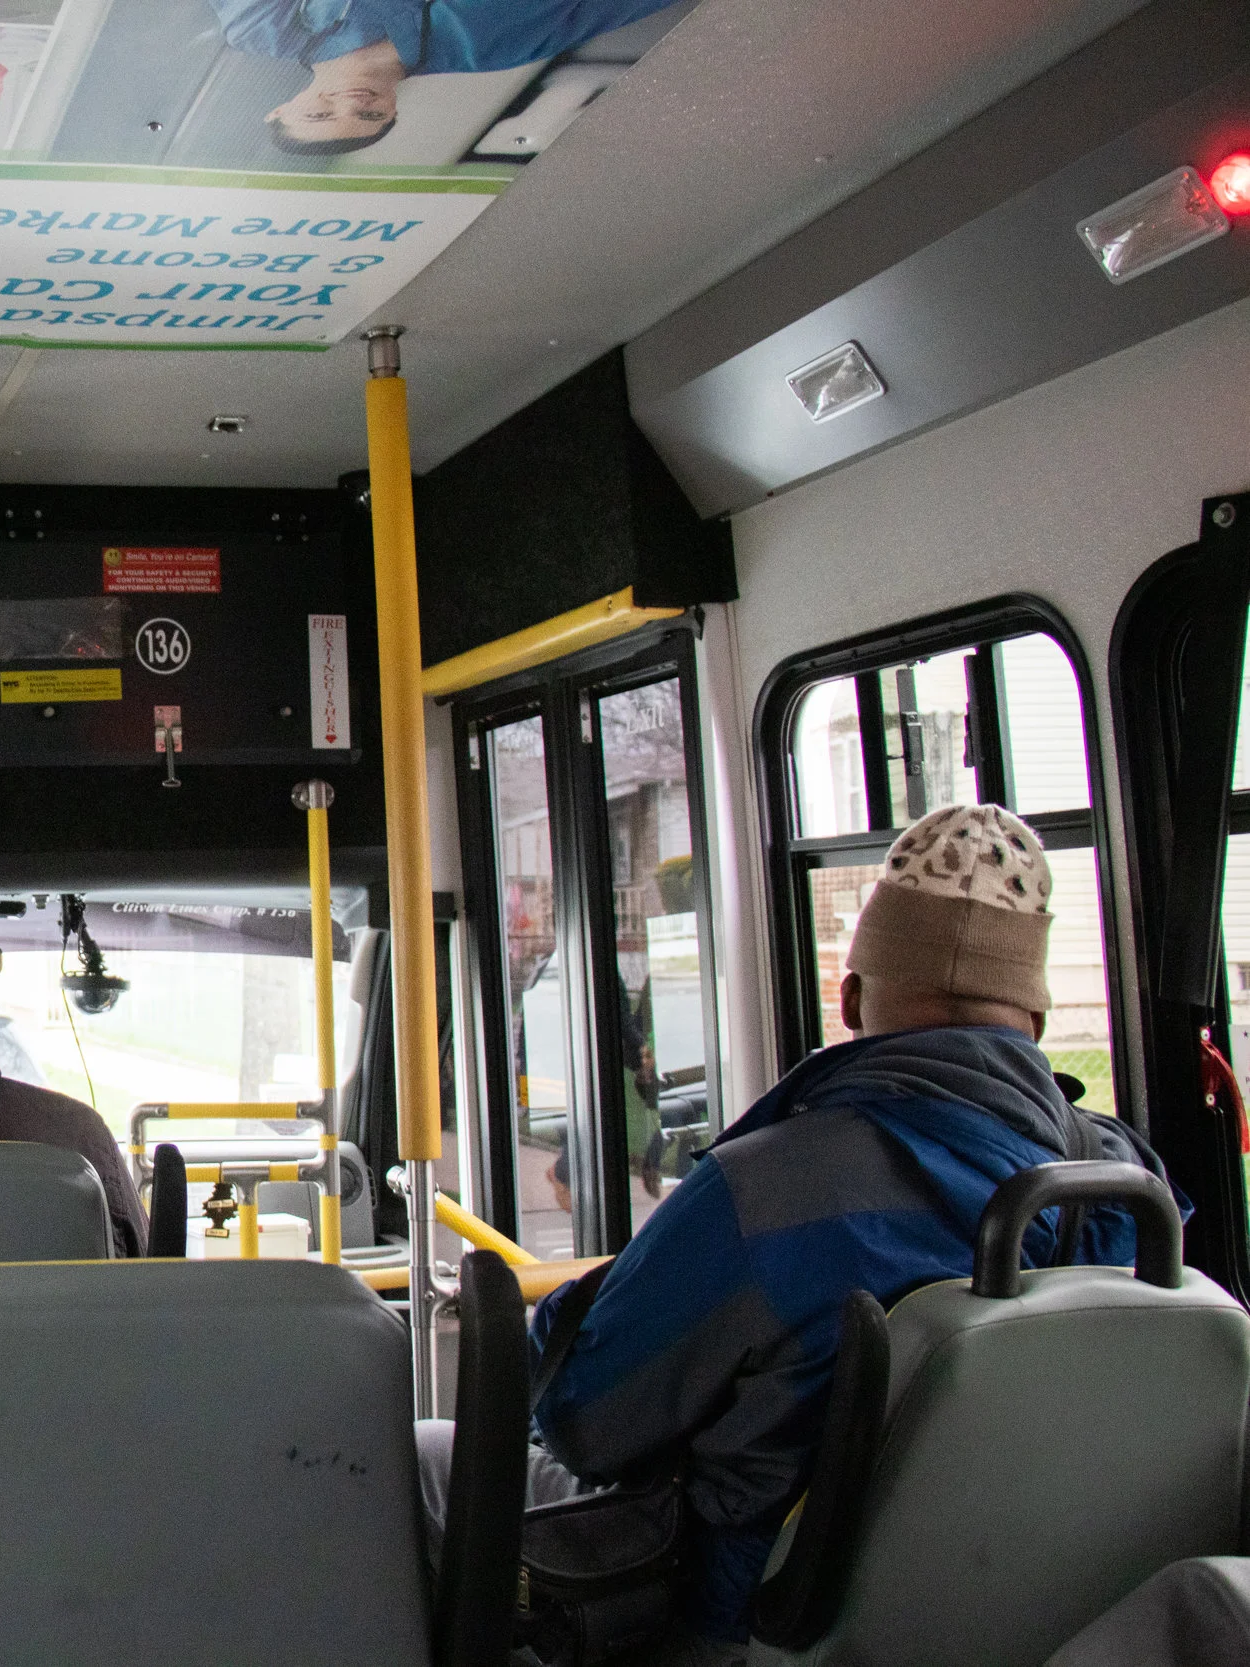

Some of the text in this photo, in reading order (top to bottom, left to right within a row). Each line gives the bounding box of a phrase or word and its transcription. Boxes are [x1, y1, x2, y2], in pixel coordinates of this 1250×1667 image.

[231, 216, 424, 242] More
[46, 248, 385, 274] & Become
[135, 282, 347, 307] Your
[108, 584, 155, 592] MONITORING
[156, 584, 167, 592] ON
[169, 584, 184, 592] THIS
[312, 618, 344, 629] FIRE
[145, 629, 184, 663] 136
[167, 903, 209, 914] Lines
